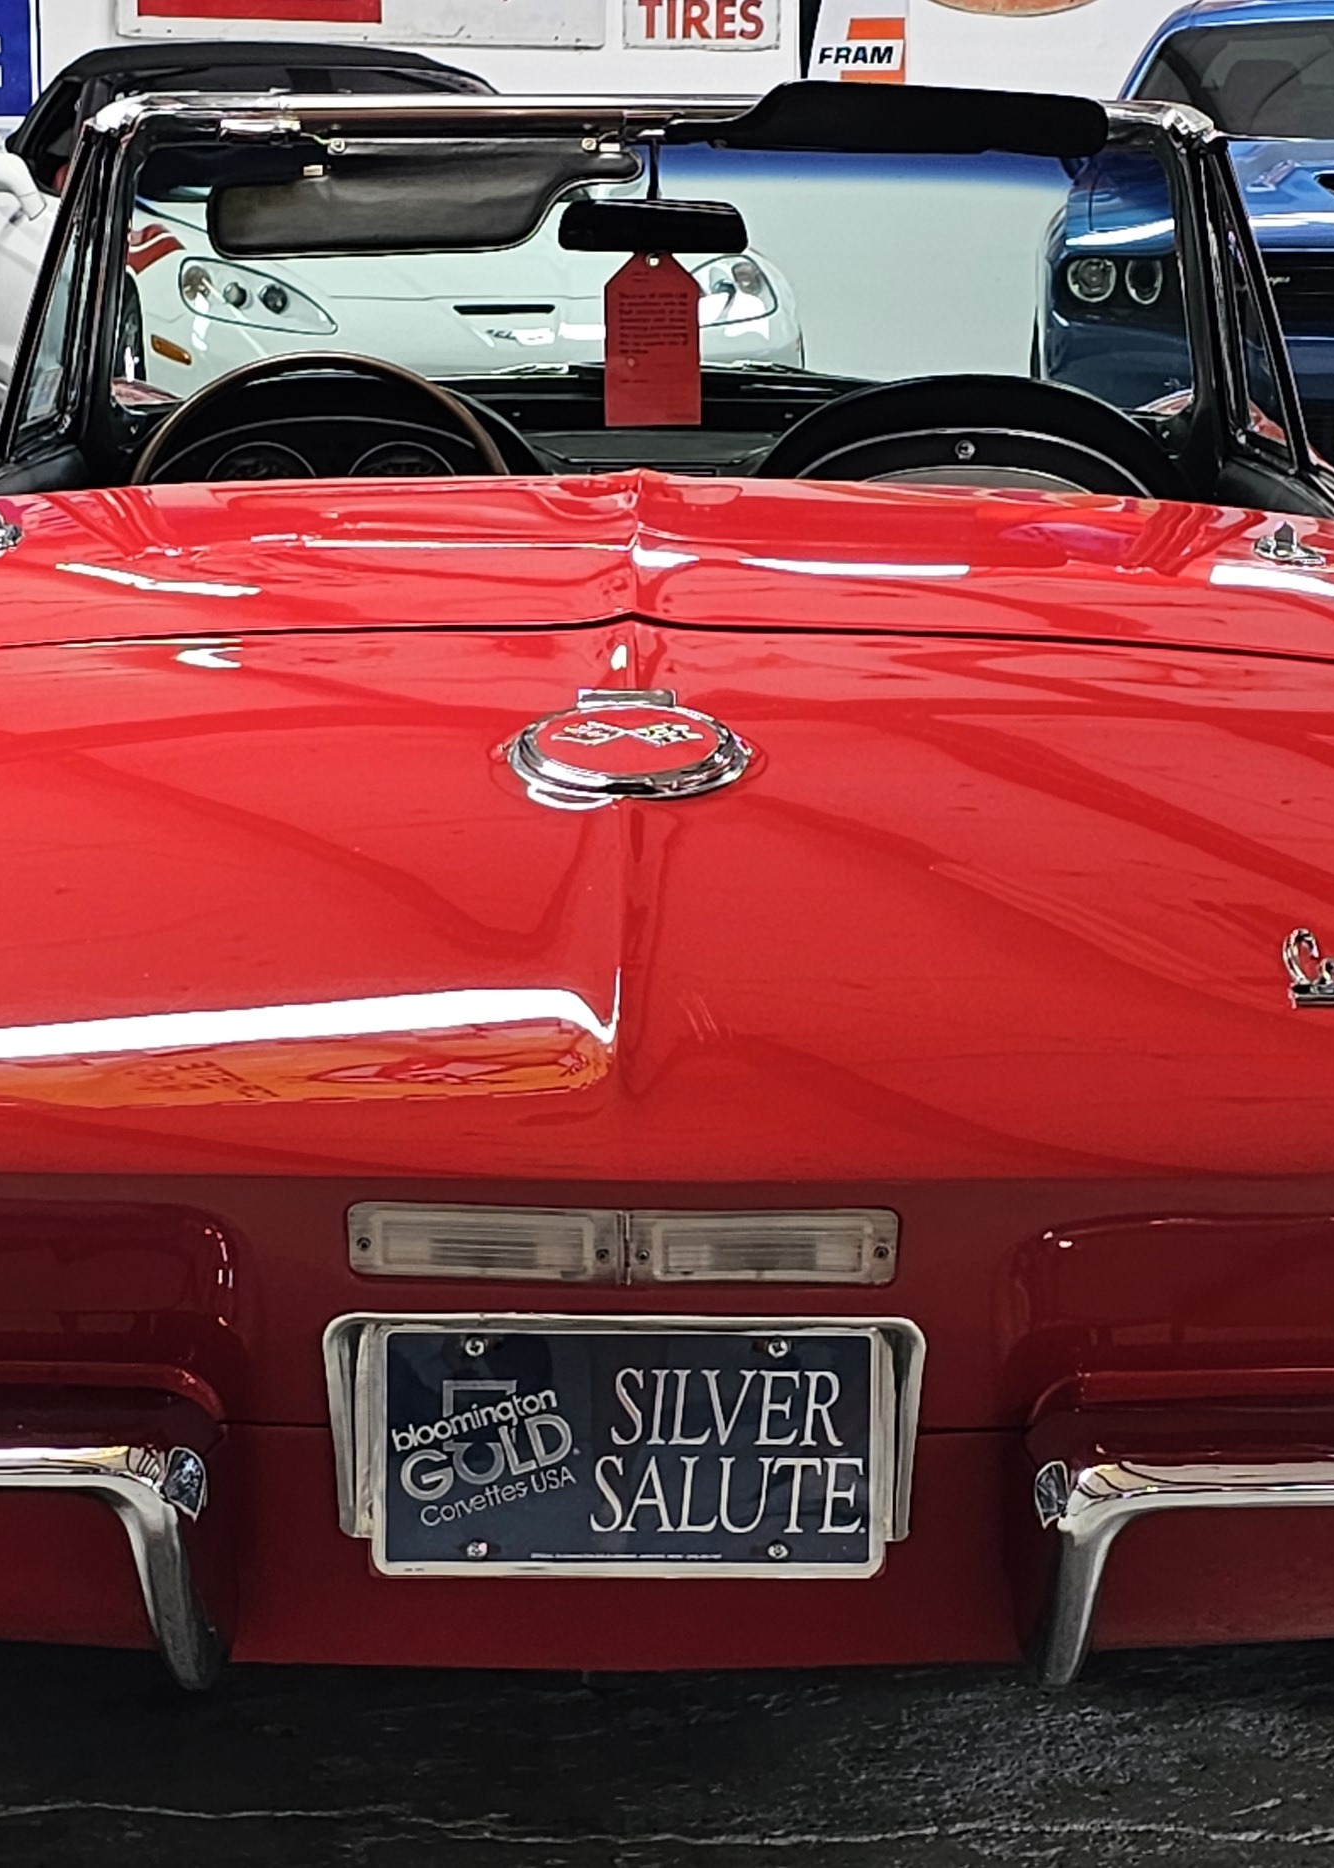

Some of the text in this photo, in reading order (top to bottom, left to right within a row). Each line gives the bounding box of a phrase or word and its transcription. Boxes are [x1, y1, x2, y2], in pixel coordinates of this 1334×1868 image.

[638, 0, 765, 40] TIRES
[818, 46, 894, 65] FRAM
[392, 1389, 558, 1452] bloomington
[611, 1367, 844, 1447] SILVER
[400, 1413, 573, 1501] GOLD
[420, 1466, 577, 1527] Corvettes USA
